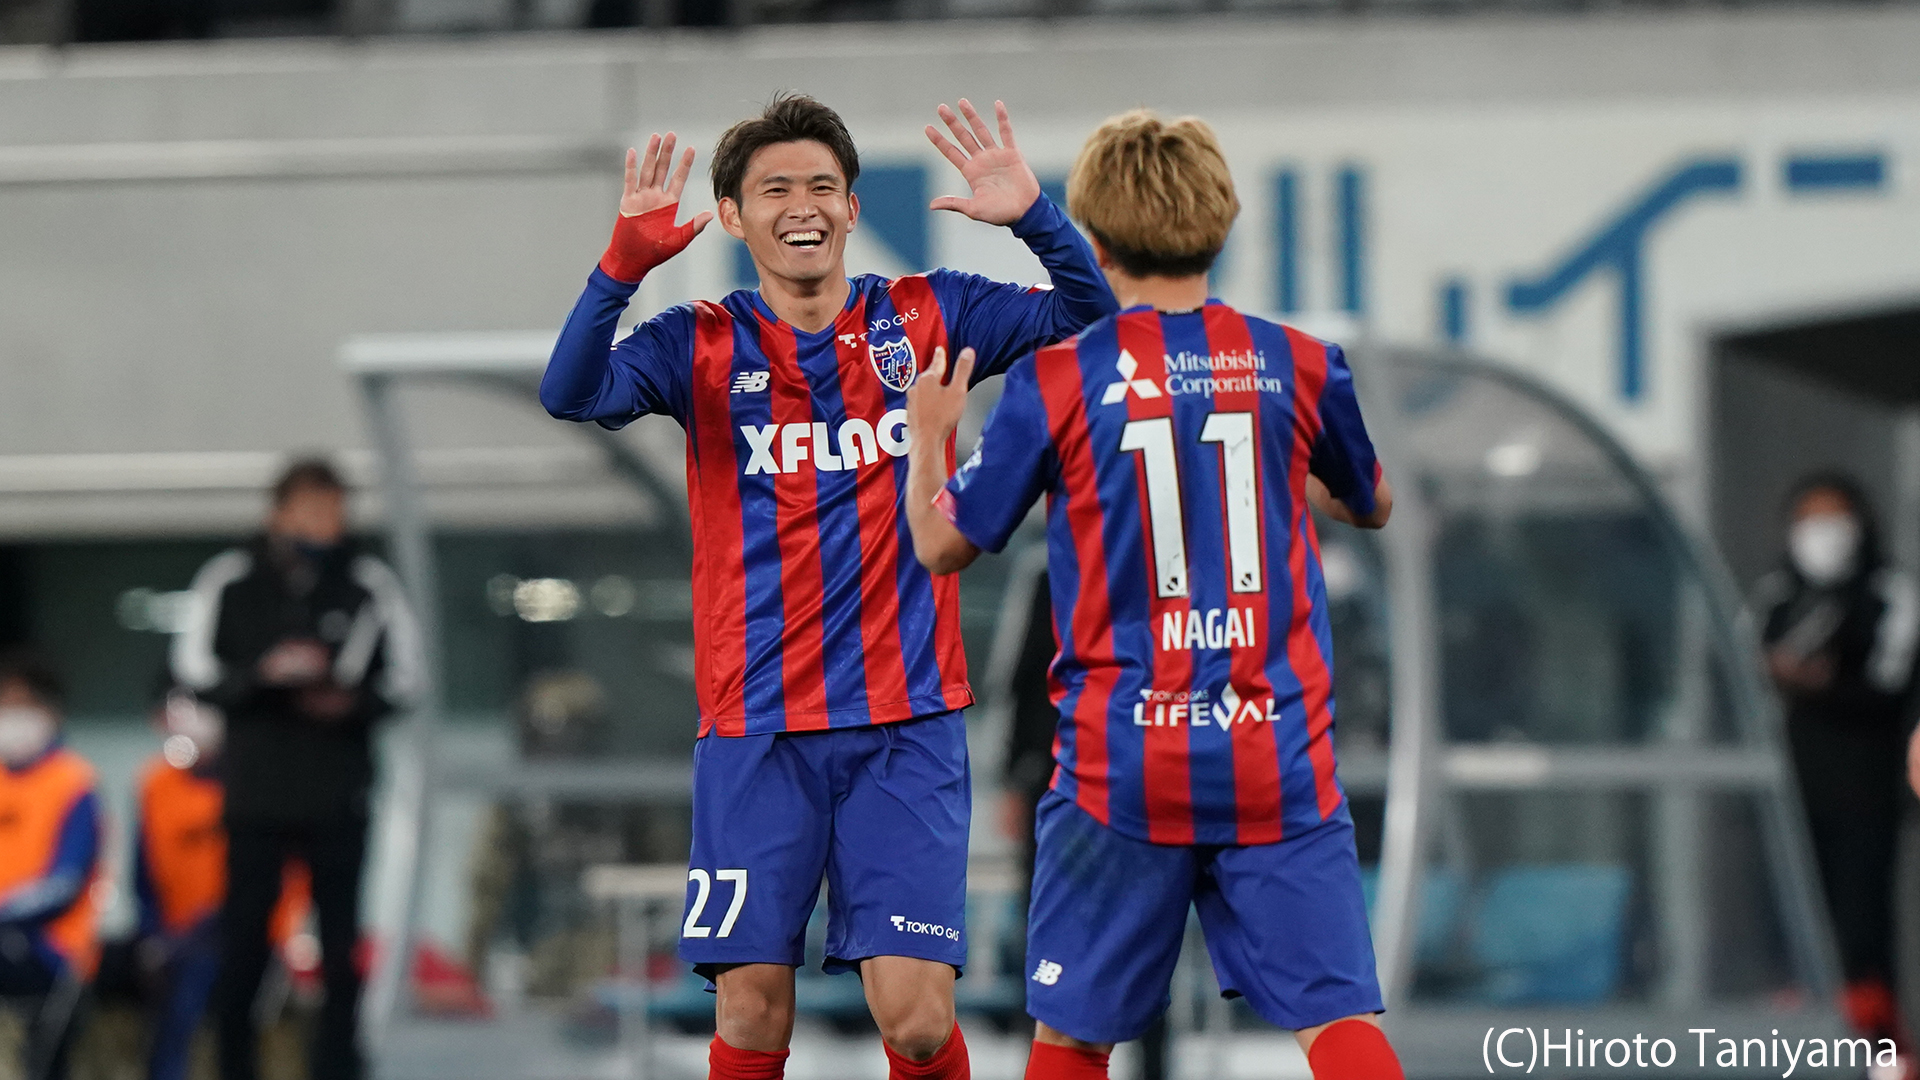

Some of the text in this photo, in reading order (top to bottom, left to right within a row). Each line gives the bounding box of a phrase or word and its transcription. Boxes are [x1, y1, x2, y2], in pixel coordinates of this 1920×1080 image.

[892, 307, 919, 326] GAS
[1164, 350, 1266, 373] Mitsubishi
[1164, 373, 1282, 399] Corporation
[1119, 411, 1263, 599] 11
[1162, 607, 1255, 652] NAGAI
[683, 869, 748, 939] 27
[906, 920, 960, 942] TOKYO GAS
